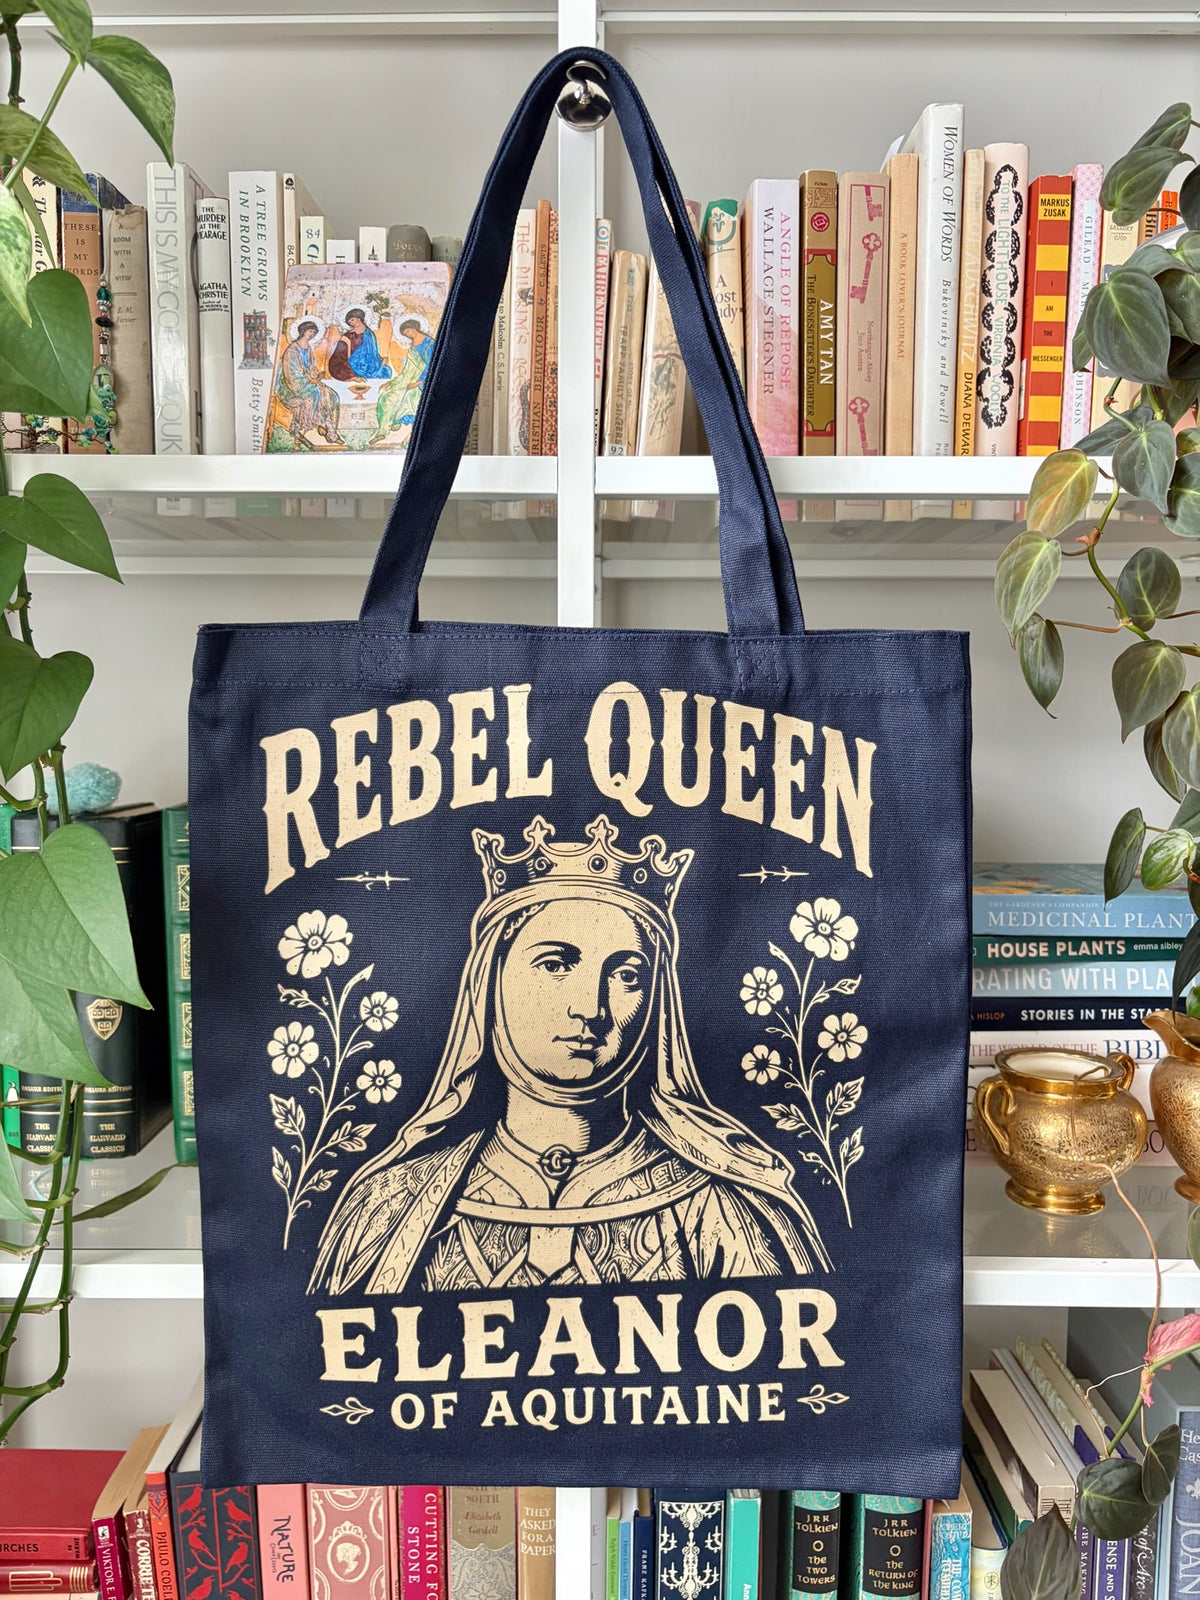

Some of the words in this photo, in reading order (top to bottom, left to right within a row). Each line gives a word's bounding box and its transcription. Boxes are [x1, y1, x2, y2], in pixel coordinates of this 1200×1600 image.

[942, 126, 958, 181] WOMEN
[154, 169, 178, 224] THIS
[239, 190, 249, 208] IN
[256, 184, 266, 194] A
[943, 186, 954, 206] OF
[1000, 180, 1010, 194] TO
[1000, 197, 1010, 214] THE
[1040, 198, 1070, 208] MARKUS
[1043, 208, 1067, 218] ZUSAK
[64, 223, 97, 232] THESE
[256, 201, 267, 240] TREE
[306, 228, 321, 239] 84
[76, 238, 85, 246] IS
[156, 230, 178, 247] IS
[516, 222, 531, 255] THE
[780, 212, 792, 278] ANGLE
[941, 211, 956, 262] WORDS
[1083, 216, 1094, 264] GILEAD
[73, 253, 88, 261] MY
[239, 214, 251, 297] BROOKLYN
[763, 206, 775, 299] WALLACE
[899, 243, 908, 270] BOOK
[257, 247, 268, 301] GROWS
[715, 274, 727, 288] A
[715, 291, 737, 304] ost
[780, 284, 791, 308] OF
[497, 316, 506, 350] Malcolm
[819, 299, 834, 343] AMY
[534, 315, 545, 391] BEHAVIOUR
[763, 305, 774, 395] STEGNER
[779, 314, 792, 390] REPOSE
[864, 320, 875, 363] Northanger
[991, 316, 1004, 366] VIRGINIA
[819, 350, 834, 385] TAN
[857, 347, 865, 372] Austen
[939, 356, 949, 376] and
[1032, 354, 1064, 363] MESSENGER
[251, 377, 264, 411] Betty
[939, 384, 949, 424] Powell
[962, 372, 974, 410] DIANA
[259, 683, 554, 895] REBEL
[583, 680, 877, 879] QUEEN
[987, 911, 1117, 928] MEDICINAL
[1124, 912, 1197, 929] PLANT
[987, 942, 1049, 958] HOUSE
[1056, 940, 1126, 956] PLANTS
[1133, 943, 1158, 951] emma
[971, 967, 1053, 991] RATING
[1061, 967, 1117, 990] WITH
[1020, 1009, 1075, 1021] STORIES
[1080, 1009, 1095, 1020] IN
[1101, 1008, 1124, 1020] THE
[314, 1288, 846, 1383] ELEANOR
[390, 1391, 458, 1431] OF
[480, 1383, 786, 1432] AQUITAINE
[523, 1506, 551, 1517] THEY
[795, 1521, 839, 1533] TOLKIEN
[424, 1492, 438, 1574] CUTTING
[522, 1531, 543, 1543] FOR
[544, 1534, 553, 1543] A
[872, 1527, 918, 1538] TOLKIEN
[136, 1539, 154, 1585] CORRIE
[156, 1532, 169, 1566] PAULO
[269, 1515, 294, 1583] NATURE
[407, 1526, 420, 1584] STONE
[1106, 1540, 1118, 1570] ENSE
[101, 1548, 115, 1585] VIKTOR
[907, 1569, 918, 1578] OF
[1135, 1552, 1152, 1588] Arc
[892, 1580, 914, 1590] KING
[1106, 1573, 1114, 1592] AND
